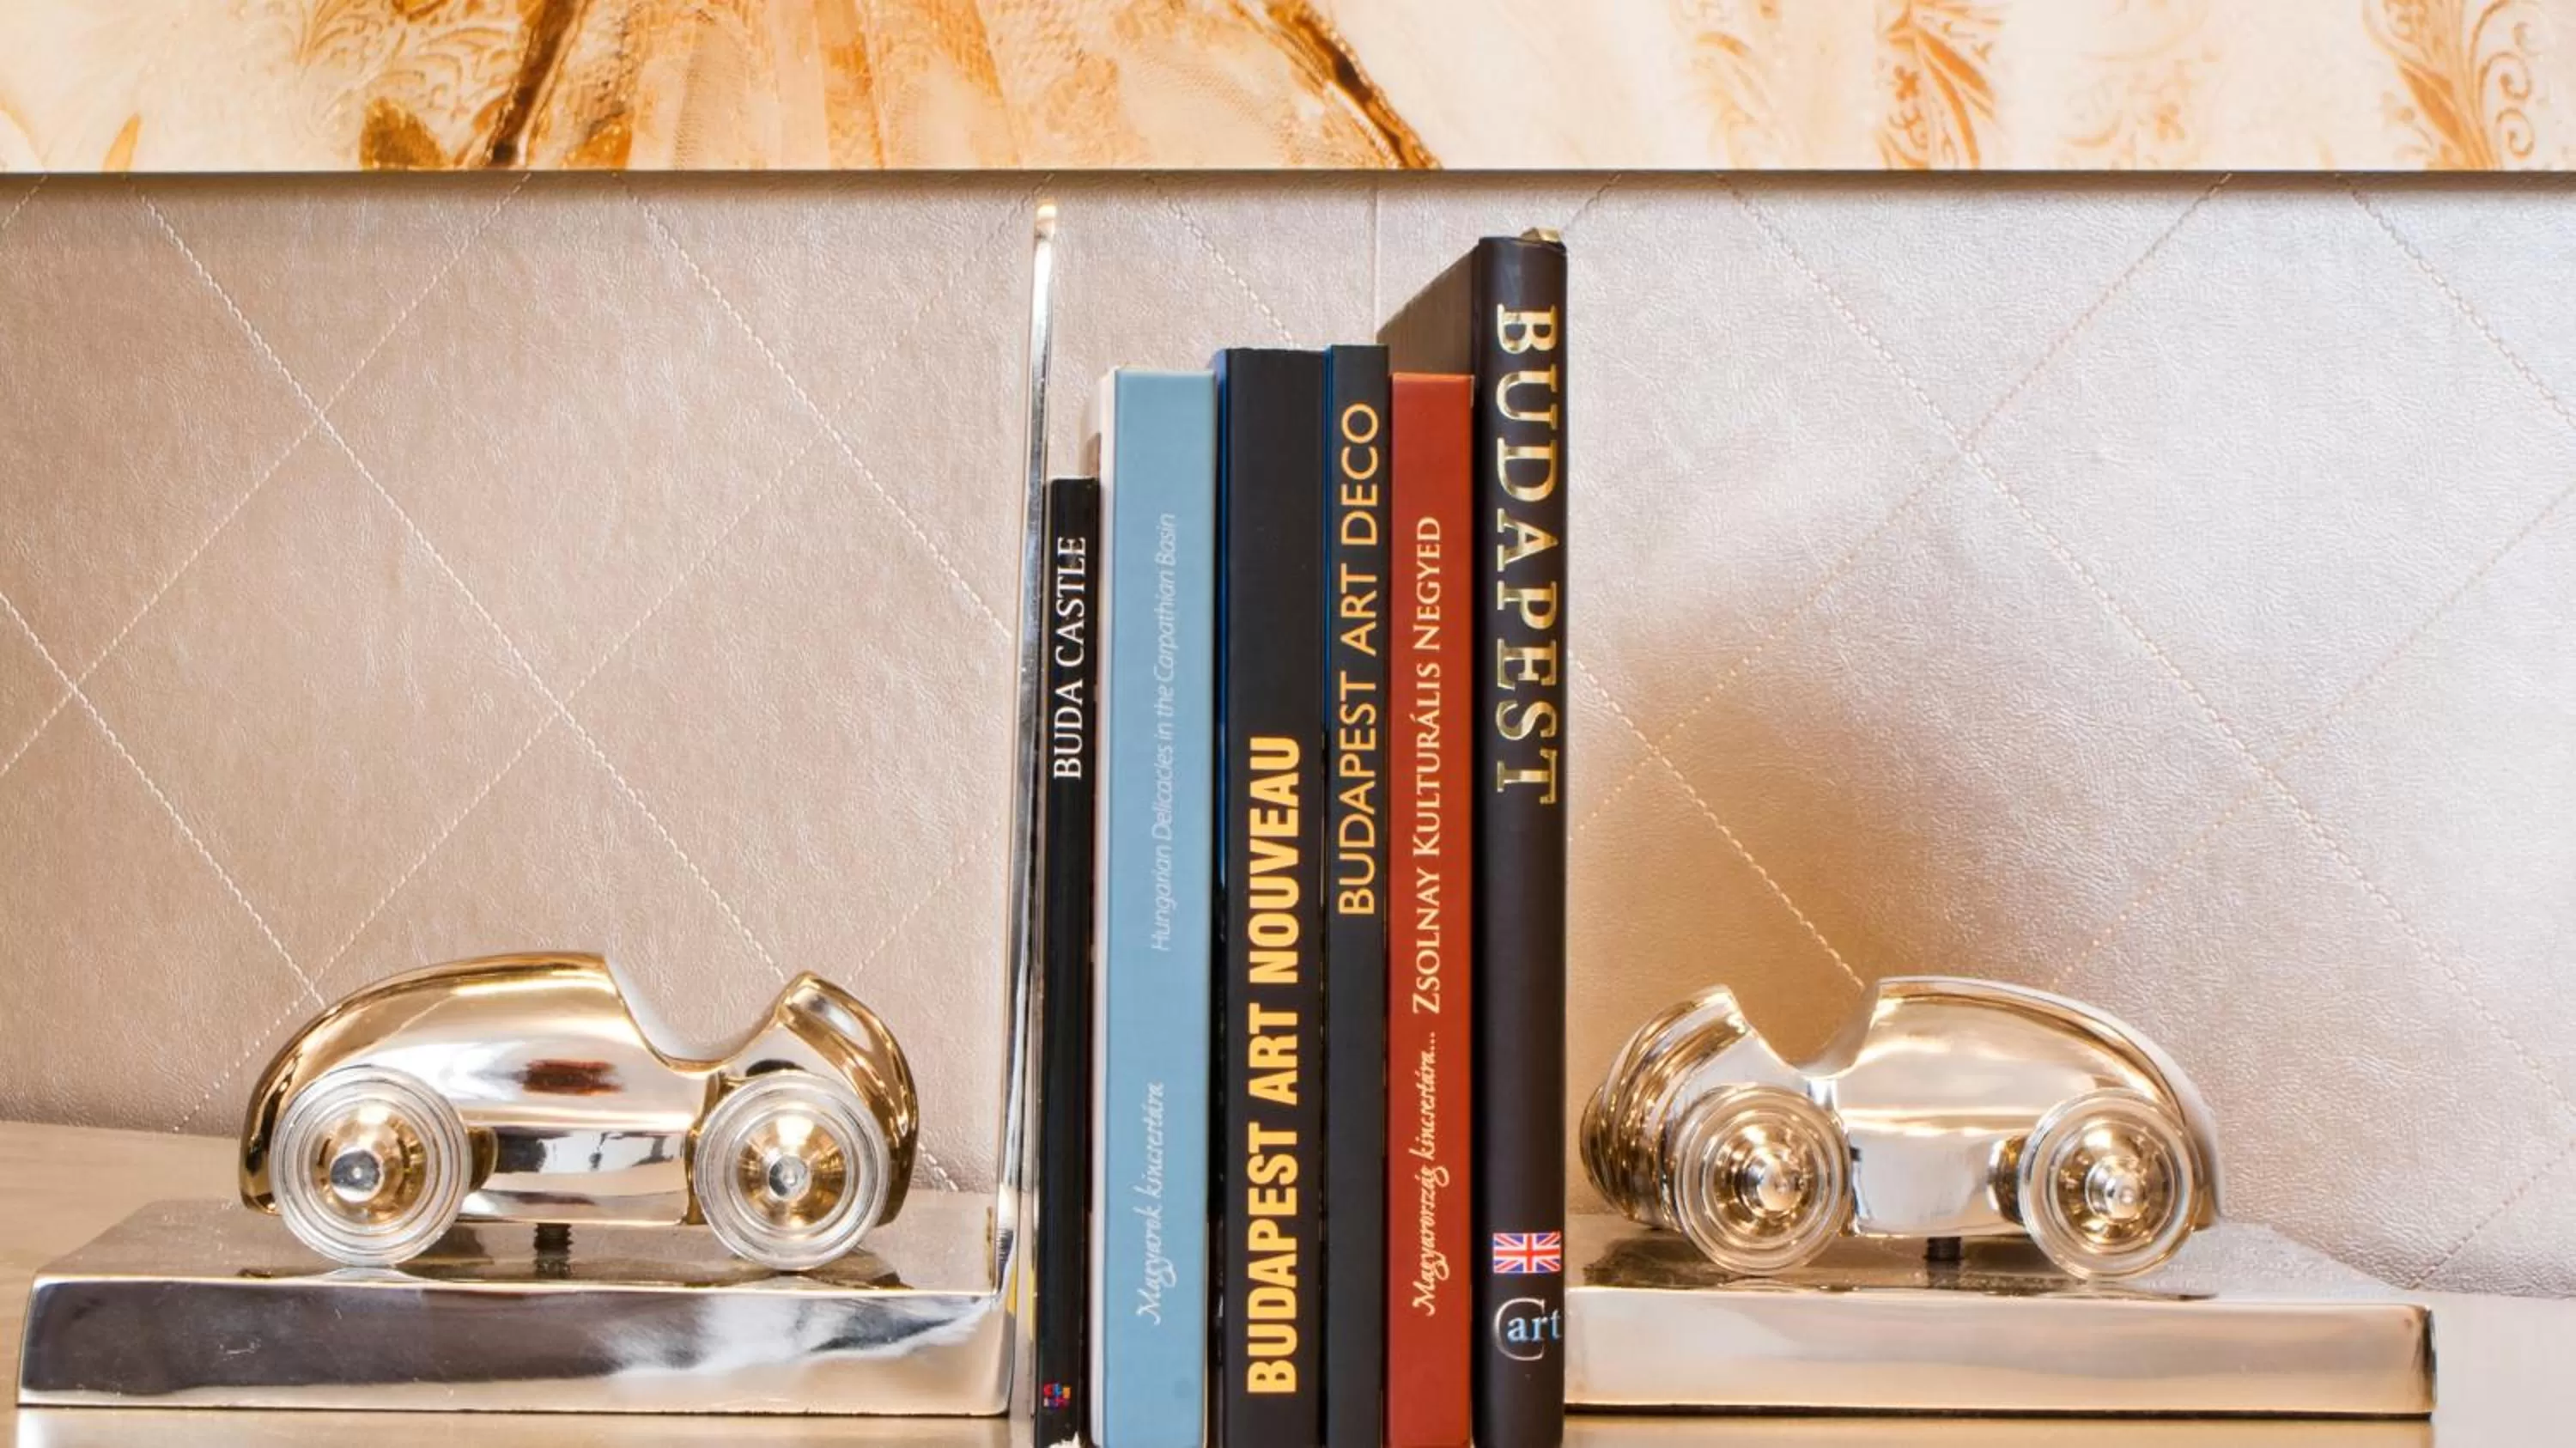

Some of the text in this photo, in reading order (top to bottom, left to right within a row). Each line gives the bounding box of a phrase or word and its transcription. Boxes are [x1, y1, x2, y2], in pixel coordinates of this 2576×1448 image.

[1054, 536, 1087, 780] BUDA CASTLE
[1151, 513, 1180, 951] Hungarian Delicacies in the Carpathian Basin
[1339, 403, 1379, 915] BUDAPEST ART DECO
[1409, 516, 1441, 1014] ZSOLNAY KULTURÁLIS NEGYED
[1496, 304, 1558, 804] BUDAPEST
[1133, 1203, 1177, 1325] Magyarok
[1247, 737, 1301, 1393] BUDAPEST ART NOUVEAU
[1413, 1165, 1450, 1317] Magyarország
